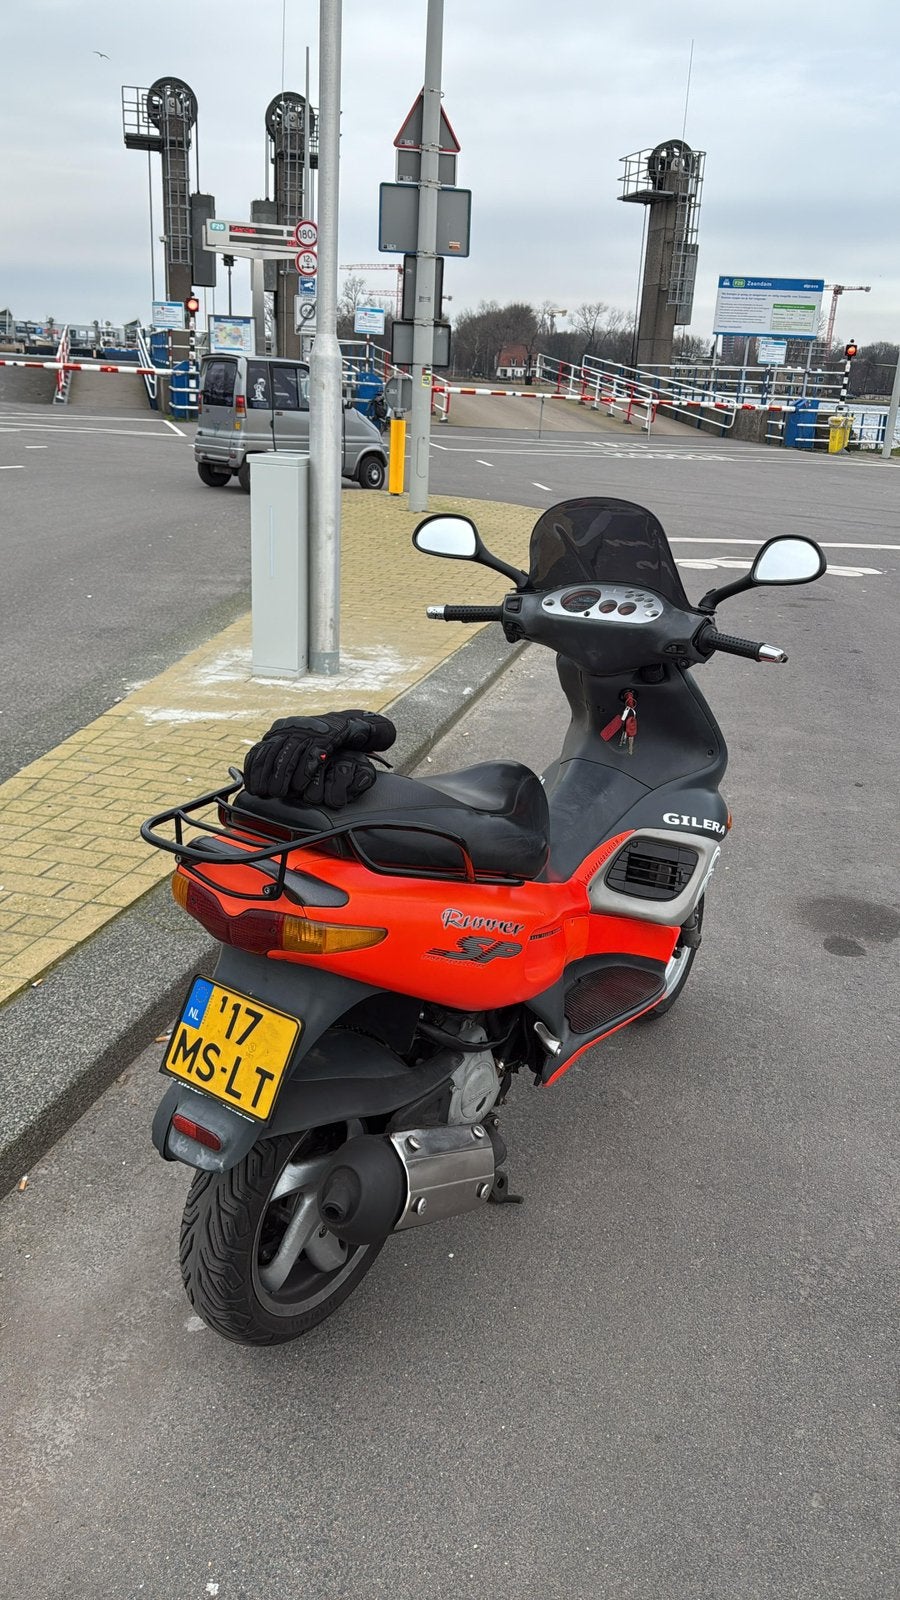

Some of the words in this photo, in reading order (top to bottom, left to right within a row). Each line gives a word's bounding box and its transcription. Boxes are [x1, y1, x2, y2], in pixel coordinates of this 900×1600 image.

[662, 812, 726, 835] GILERA
[441, 908, 525, 935] Runner
[188, 1006, 200, 1021] NL
[171, 1028, 275, 1108] MS-LT
